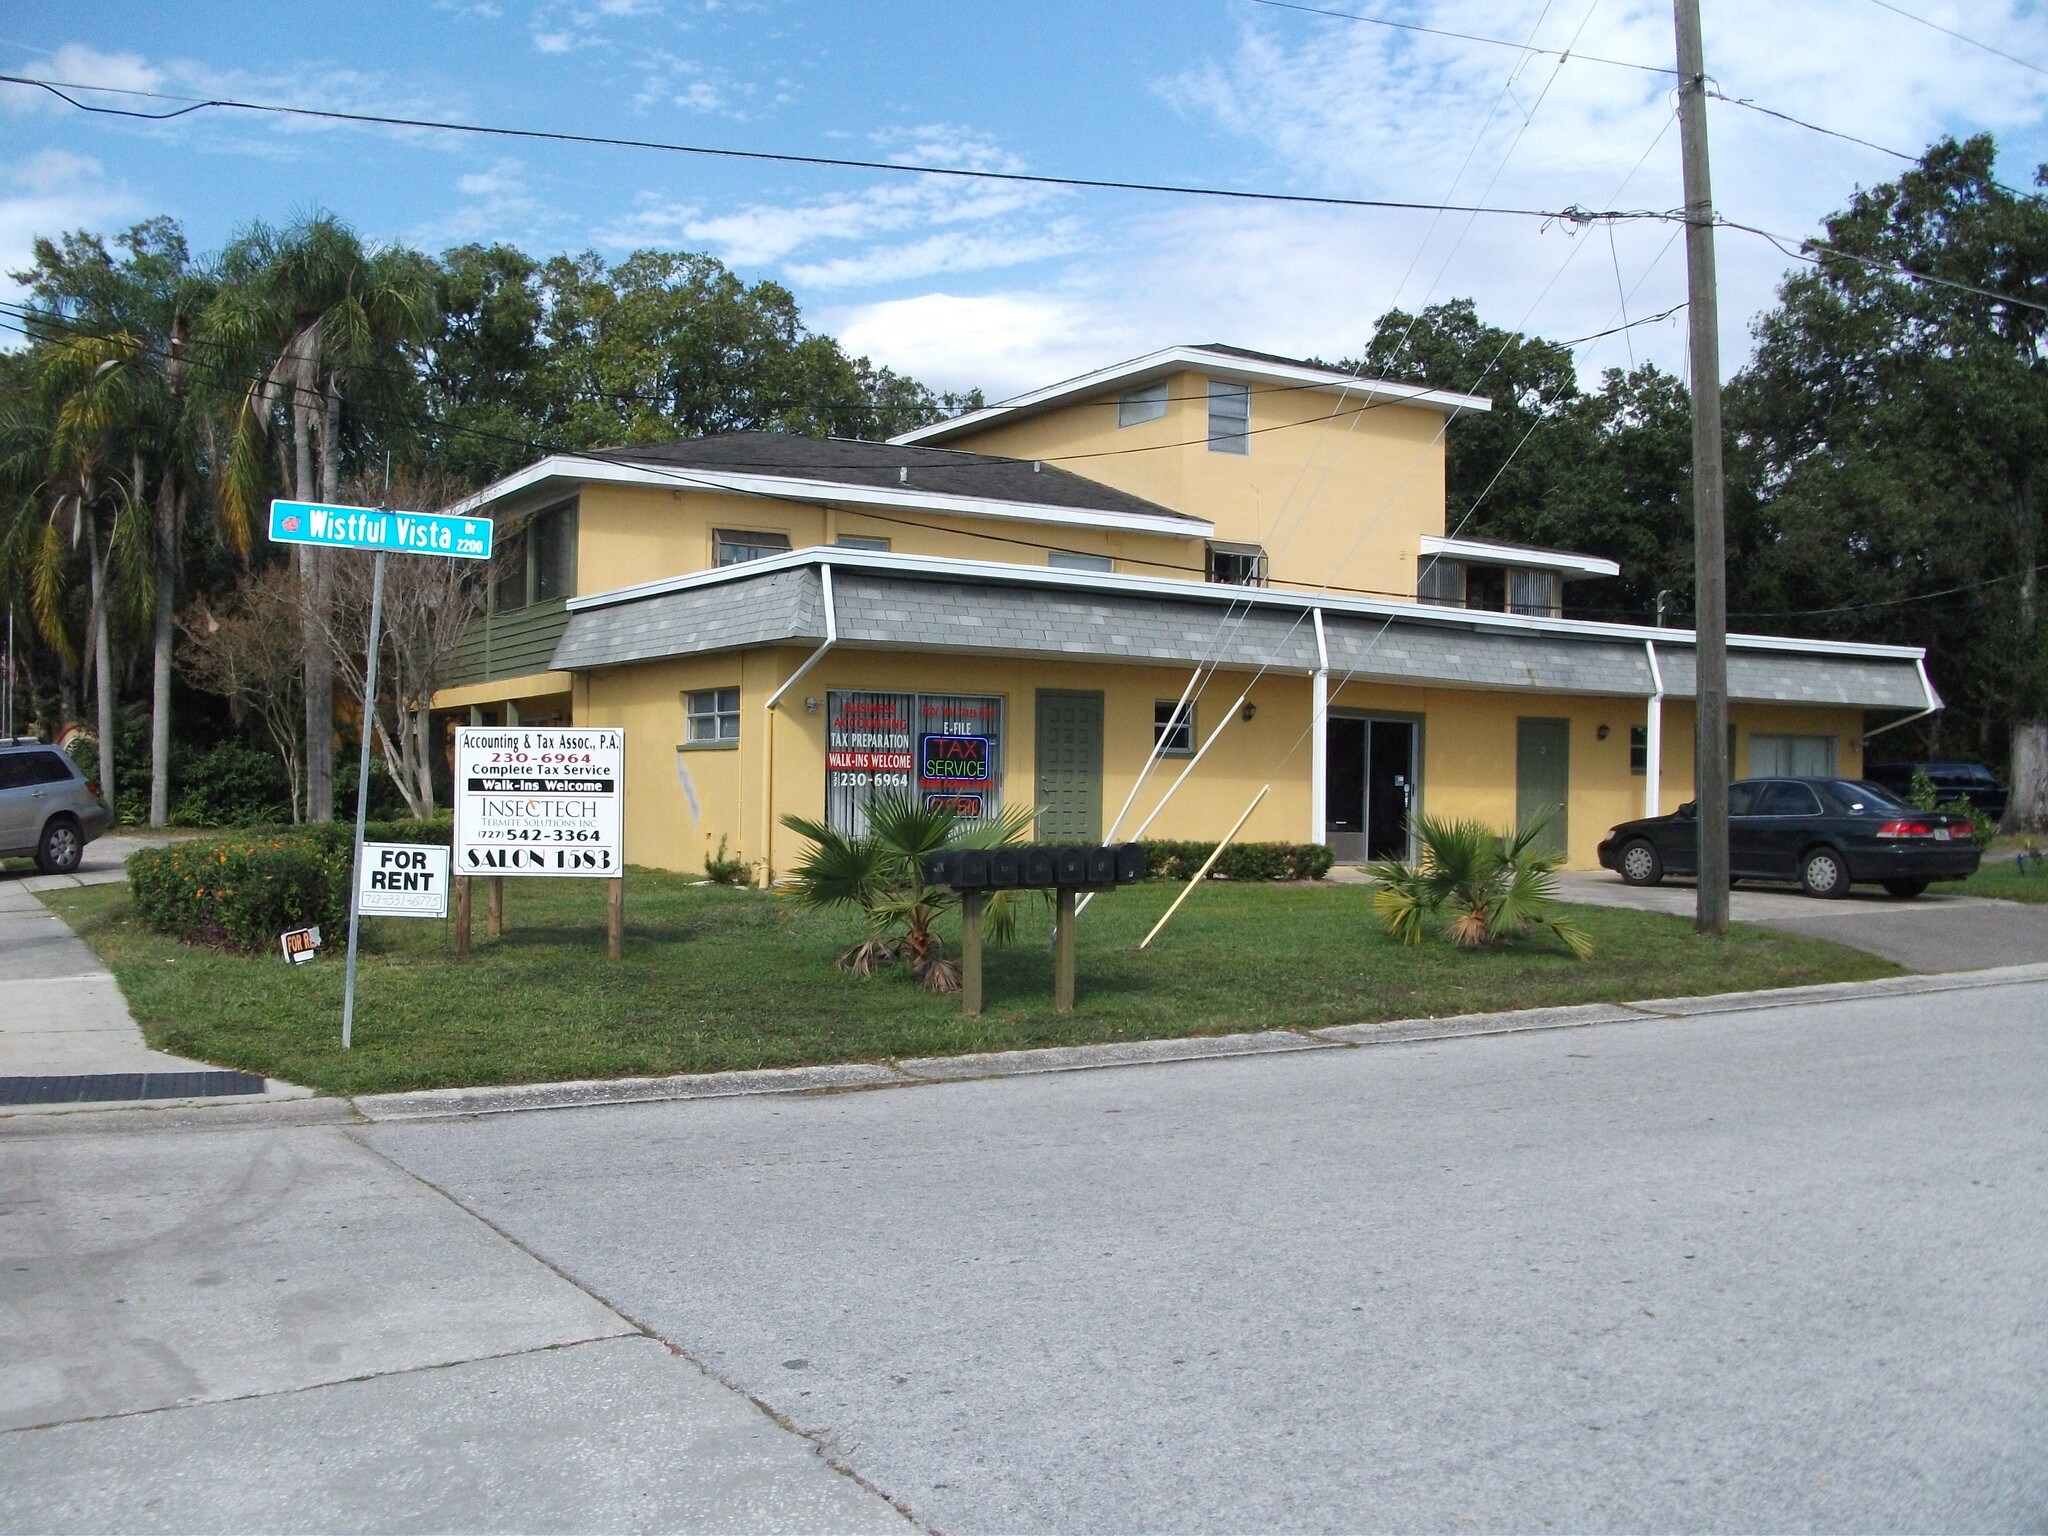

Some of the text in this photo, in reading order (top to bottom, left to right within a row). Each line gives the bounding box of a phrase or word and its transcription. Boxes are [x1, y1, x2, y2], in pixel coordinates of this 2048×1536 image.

[309, 509, 476, 549] Wistful Vista Dr
[456, 538, 483, 553] 2200
[844, 703, 896, 714] BUSINESS
[834, 717, 907, 730] ACCOUNTING
[944, 722, 971, 735] E-FILE
[463, 733, 519, 753] Accounting
[524, 734, 531, 749] &
[537, 734, 554, 749] Tax
[600, 735, 619, 750] P.A.
[830, 732, 909, 748] TAX PREPARATION
[934, 739, 977, 758] TAX
[491, 752, 592, 764] 230-6964
[829, 753, 911, 768] WALK-INS WELCOME
[472, 764, 611, 777] Complete Tax Service
[926, 760, 985, 777] SERVICE
[482, 779, 603, 792] Walk-Ins Welcome
[840, 772, 908, 787] 230-6964
[482, 797, 597, 818] INSECTECH
[482, 817, 597, 828] TERMITE SOLUTIONS INC
[478, 829, 601, 842] (727) 542-3364
[381, 850, 427, 870] FOR
[468, 848, 611, 869] SALON 1583
[371, 871, 434, 891] RENT
[287, 934, 303, 953] FOR
